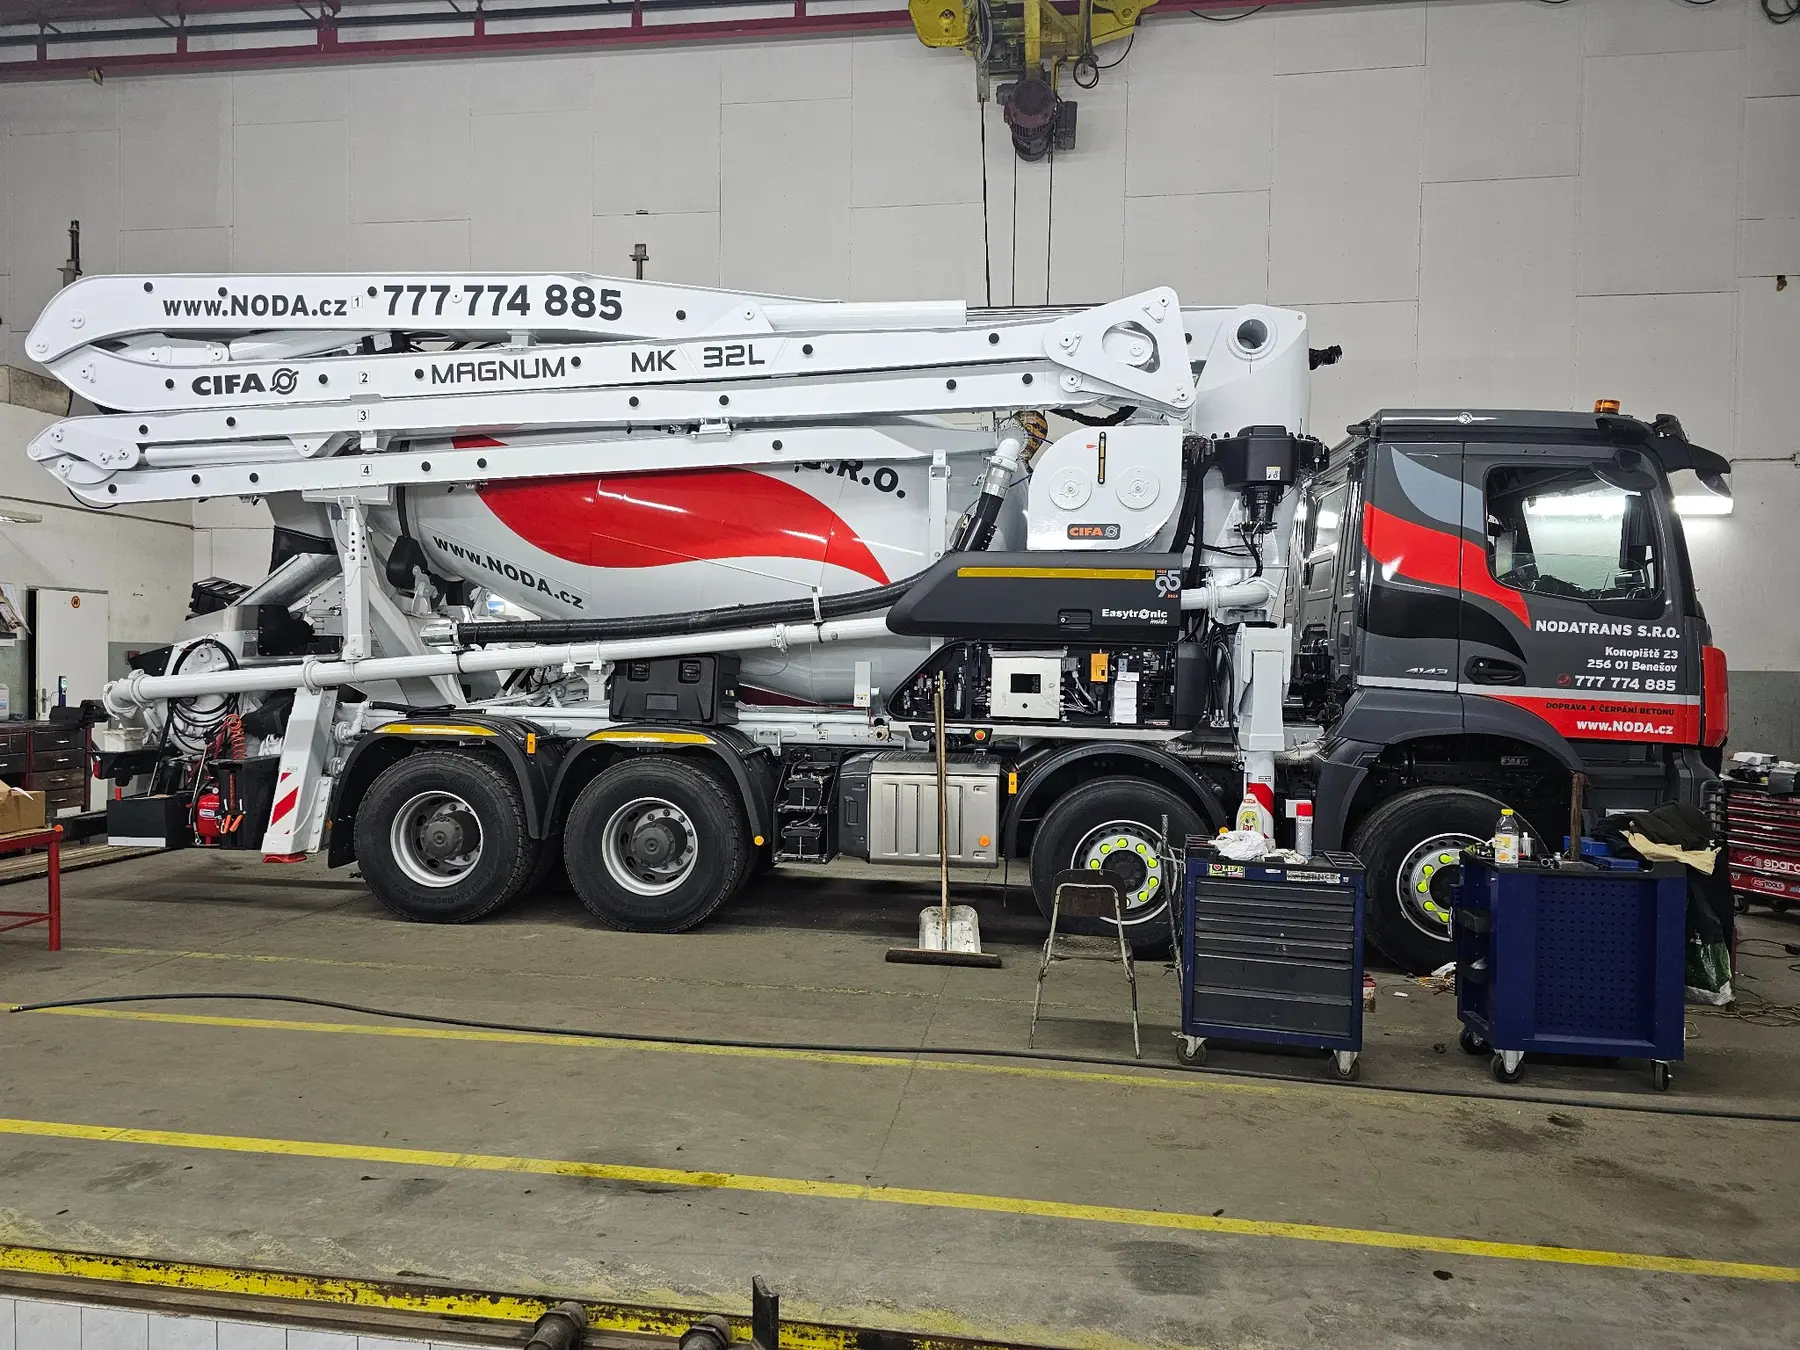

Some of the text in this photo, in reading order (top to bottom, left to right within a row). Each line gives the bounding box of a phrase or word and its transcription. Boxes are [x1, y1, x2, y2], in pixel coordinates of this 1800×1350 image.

[163, 283, 623, 321] www.NODA.cz 777 774 885
[354, 296, 361, 308] 1
[431, 344, 765, 384] MAGNUM MK 32L
[191, 373, 267, 396] CIFA
[361, 372, 369, 384] 2
[359, 410, 368, 421] 3
[362, 464, 371, 476] 4
[1069, 526, 1103, 536] CIFA
[432, 535, 585, 610] www.NODA.cz
[1101, 608, 1168, 620] Easytronic
[1535, 620, 1681, 639] NODATRANS S.R.O.
[1605, 646, 1679, 659] Konopiště 23
[1405, 667, 1449, 675] 4143
[1587, 659, 1678, 673] 256 01 Benešov
[1574, 674, 1676, 692] 777 774 885
[1545, 702, 1587, 711] DOPRAVA
[1599, 705, 1637, 715] ČERPÁNÍ
[1576, 720, 1674, 735] www.NODA.cz
[1764, 881, 1783, 889] TOOLS
